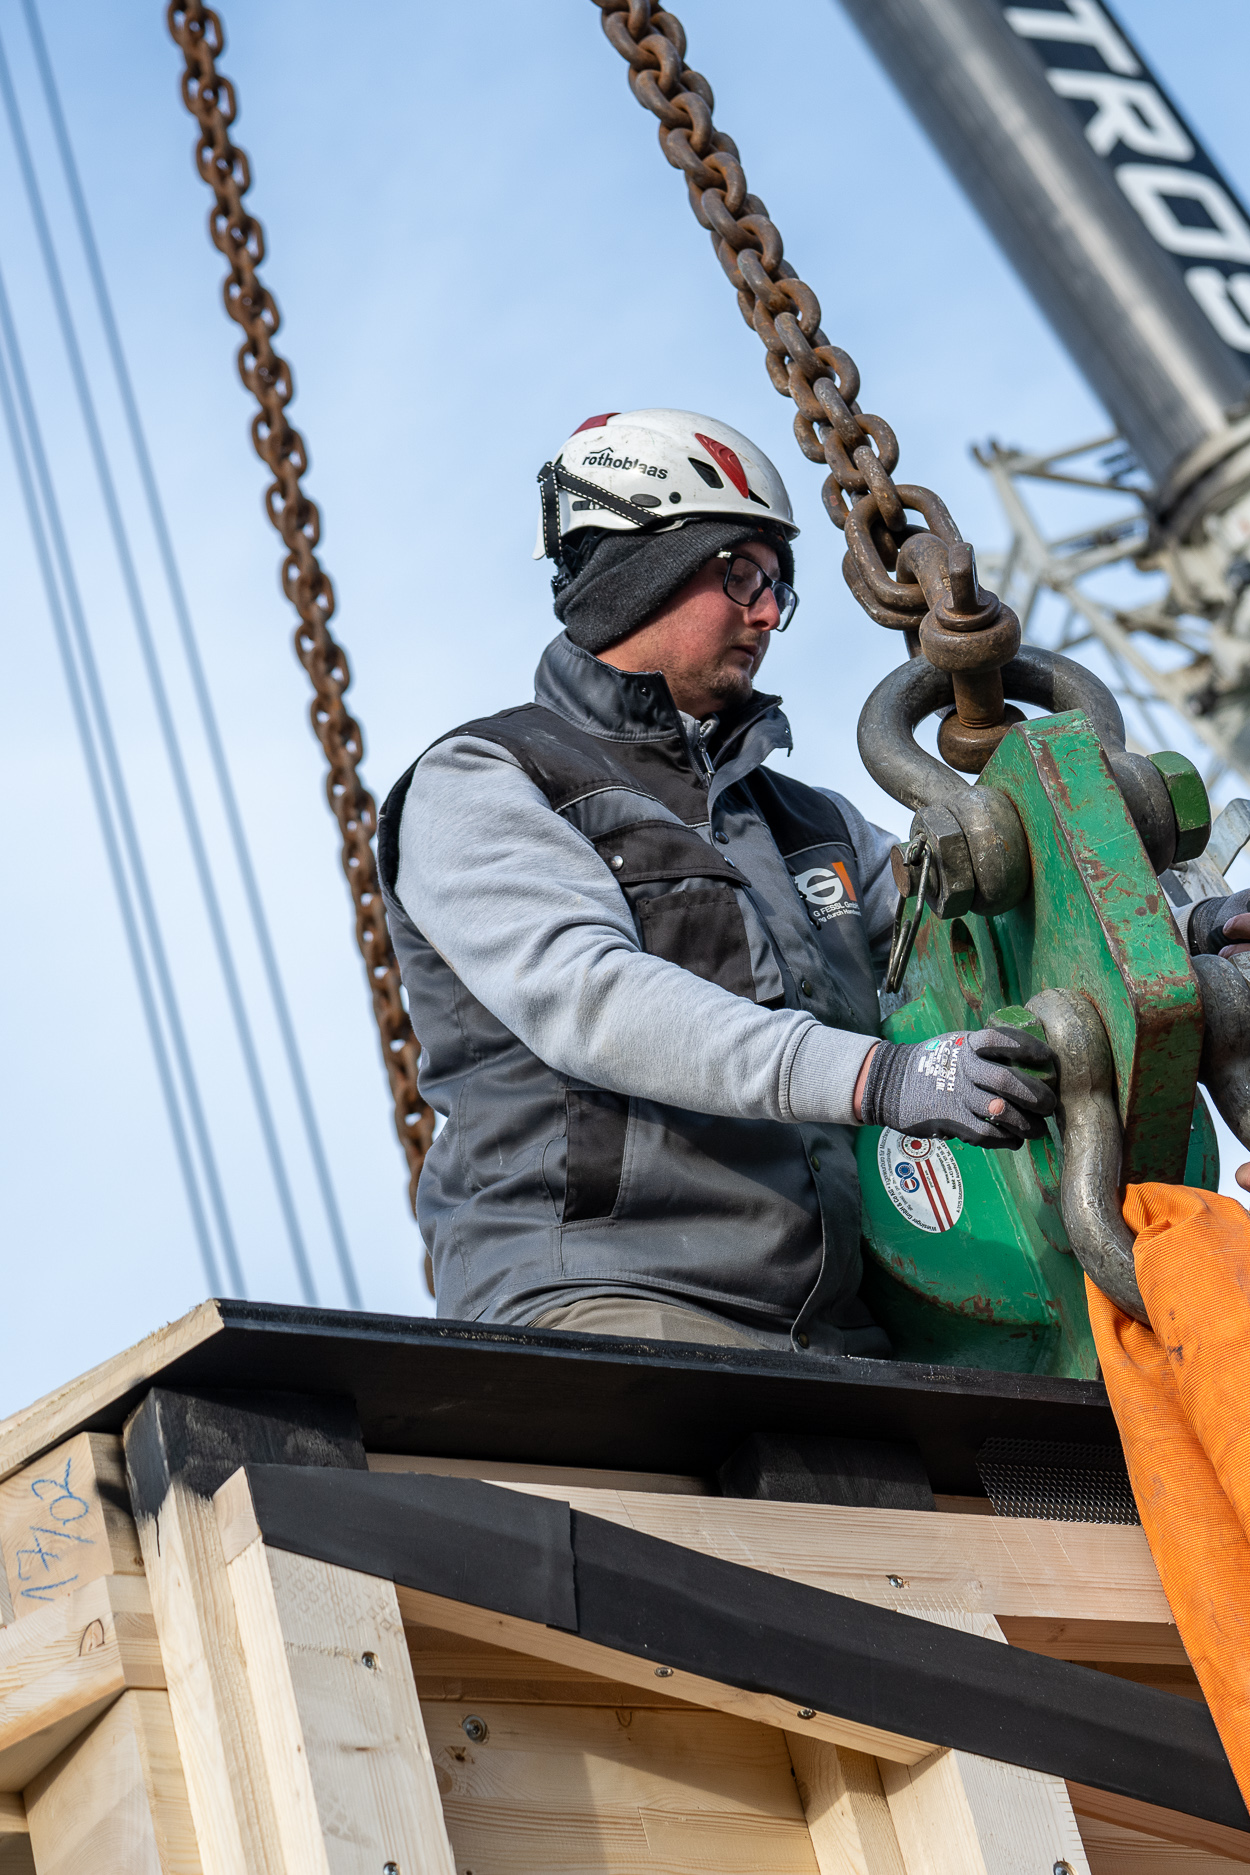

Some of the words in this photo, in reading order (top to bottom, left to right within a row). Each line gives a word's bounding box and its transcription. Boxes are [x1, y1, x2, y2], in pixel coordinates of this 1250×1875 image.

[582, 453, 668, 479] rothoblaas
[820, 902, 845, 915] FESSL
[827, 910, 844, 919] durch
